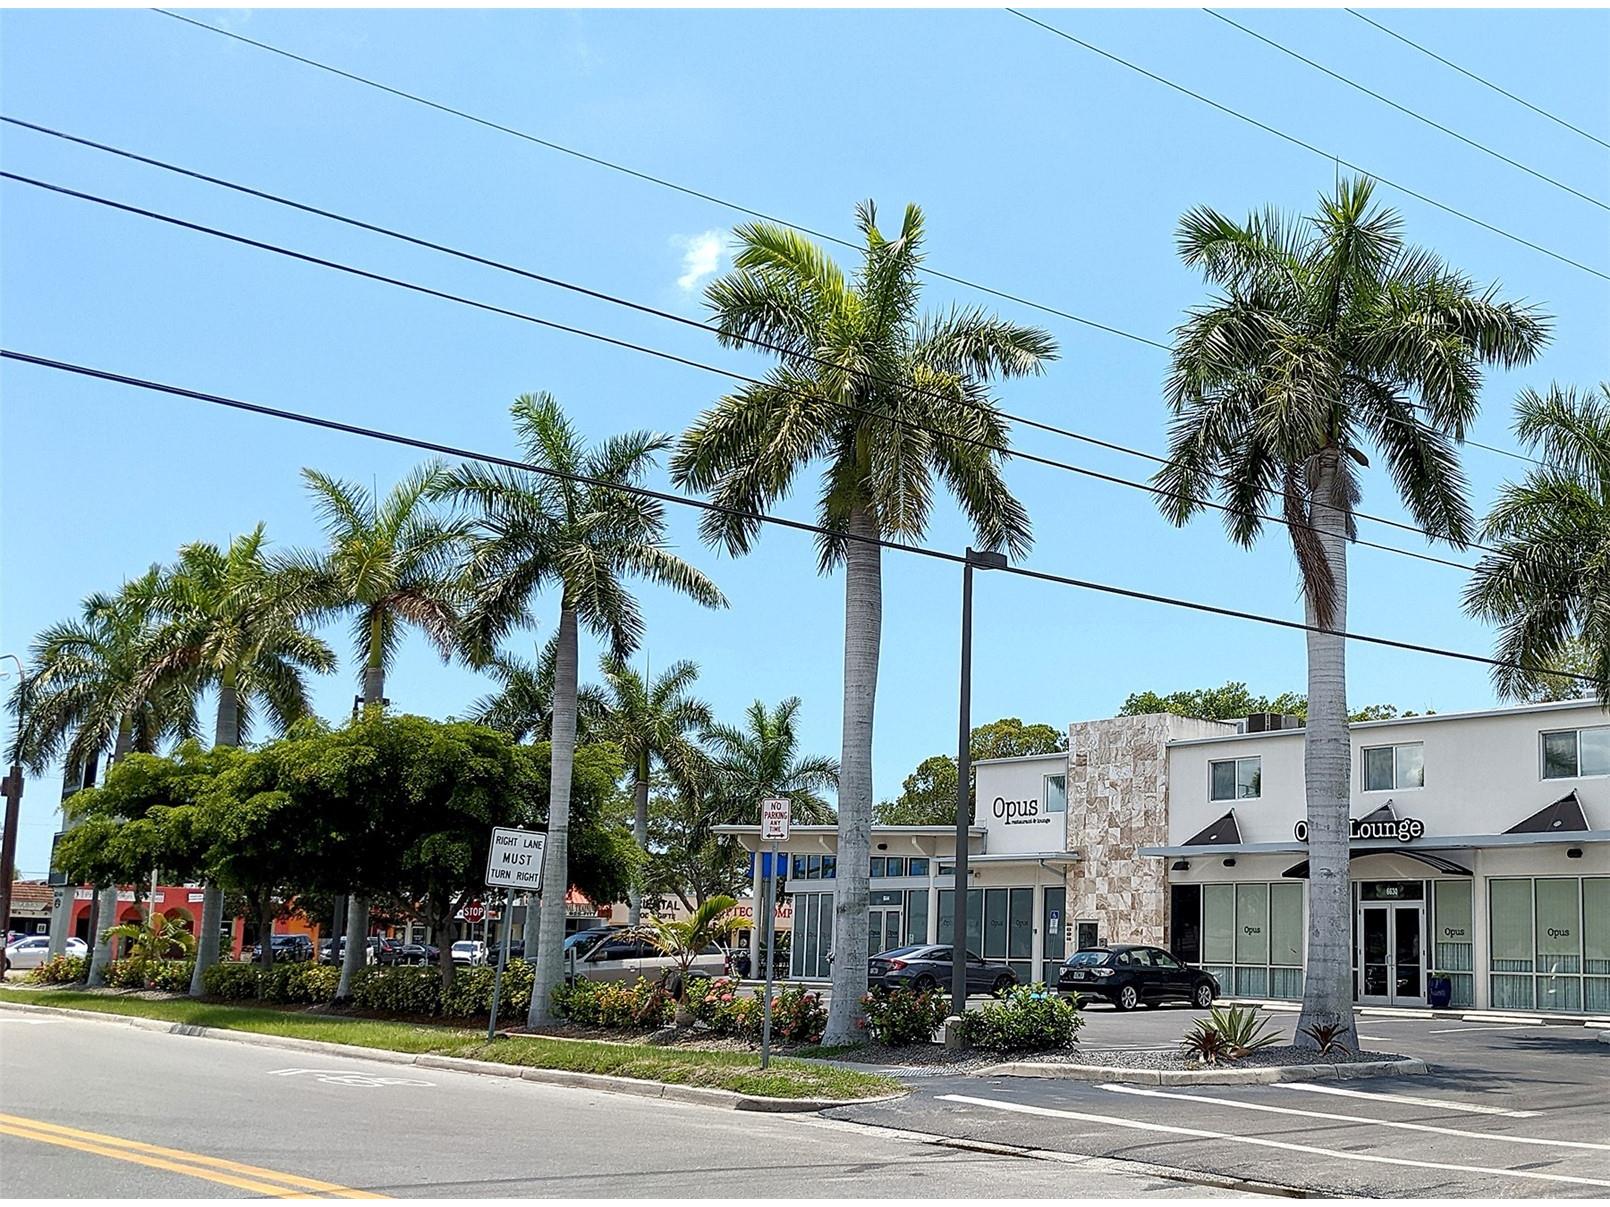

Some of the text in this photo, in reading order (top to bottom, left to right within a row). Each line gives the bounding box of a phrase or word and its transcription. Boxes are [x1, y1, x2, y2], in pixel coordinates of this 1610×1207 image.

[771, 801, 782, 811] NO
[993, 797, 1038, 825] Opus
[764, 811, 788, 820] PARKING
[1349, 819, 1423, 842] Lounge
[495, 835, 543, 850] RIGHT LANE
[502, 852, 532, 866] MUST
[491, 868, 539, 882] TURN RIGHT
[464, 906, 484, 917] STOP
[1244, 926, 1261, 936] Opus
[1444, 927, 1465, 938] Opus
[1547, 927, 1570, 939] Opus
